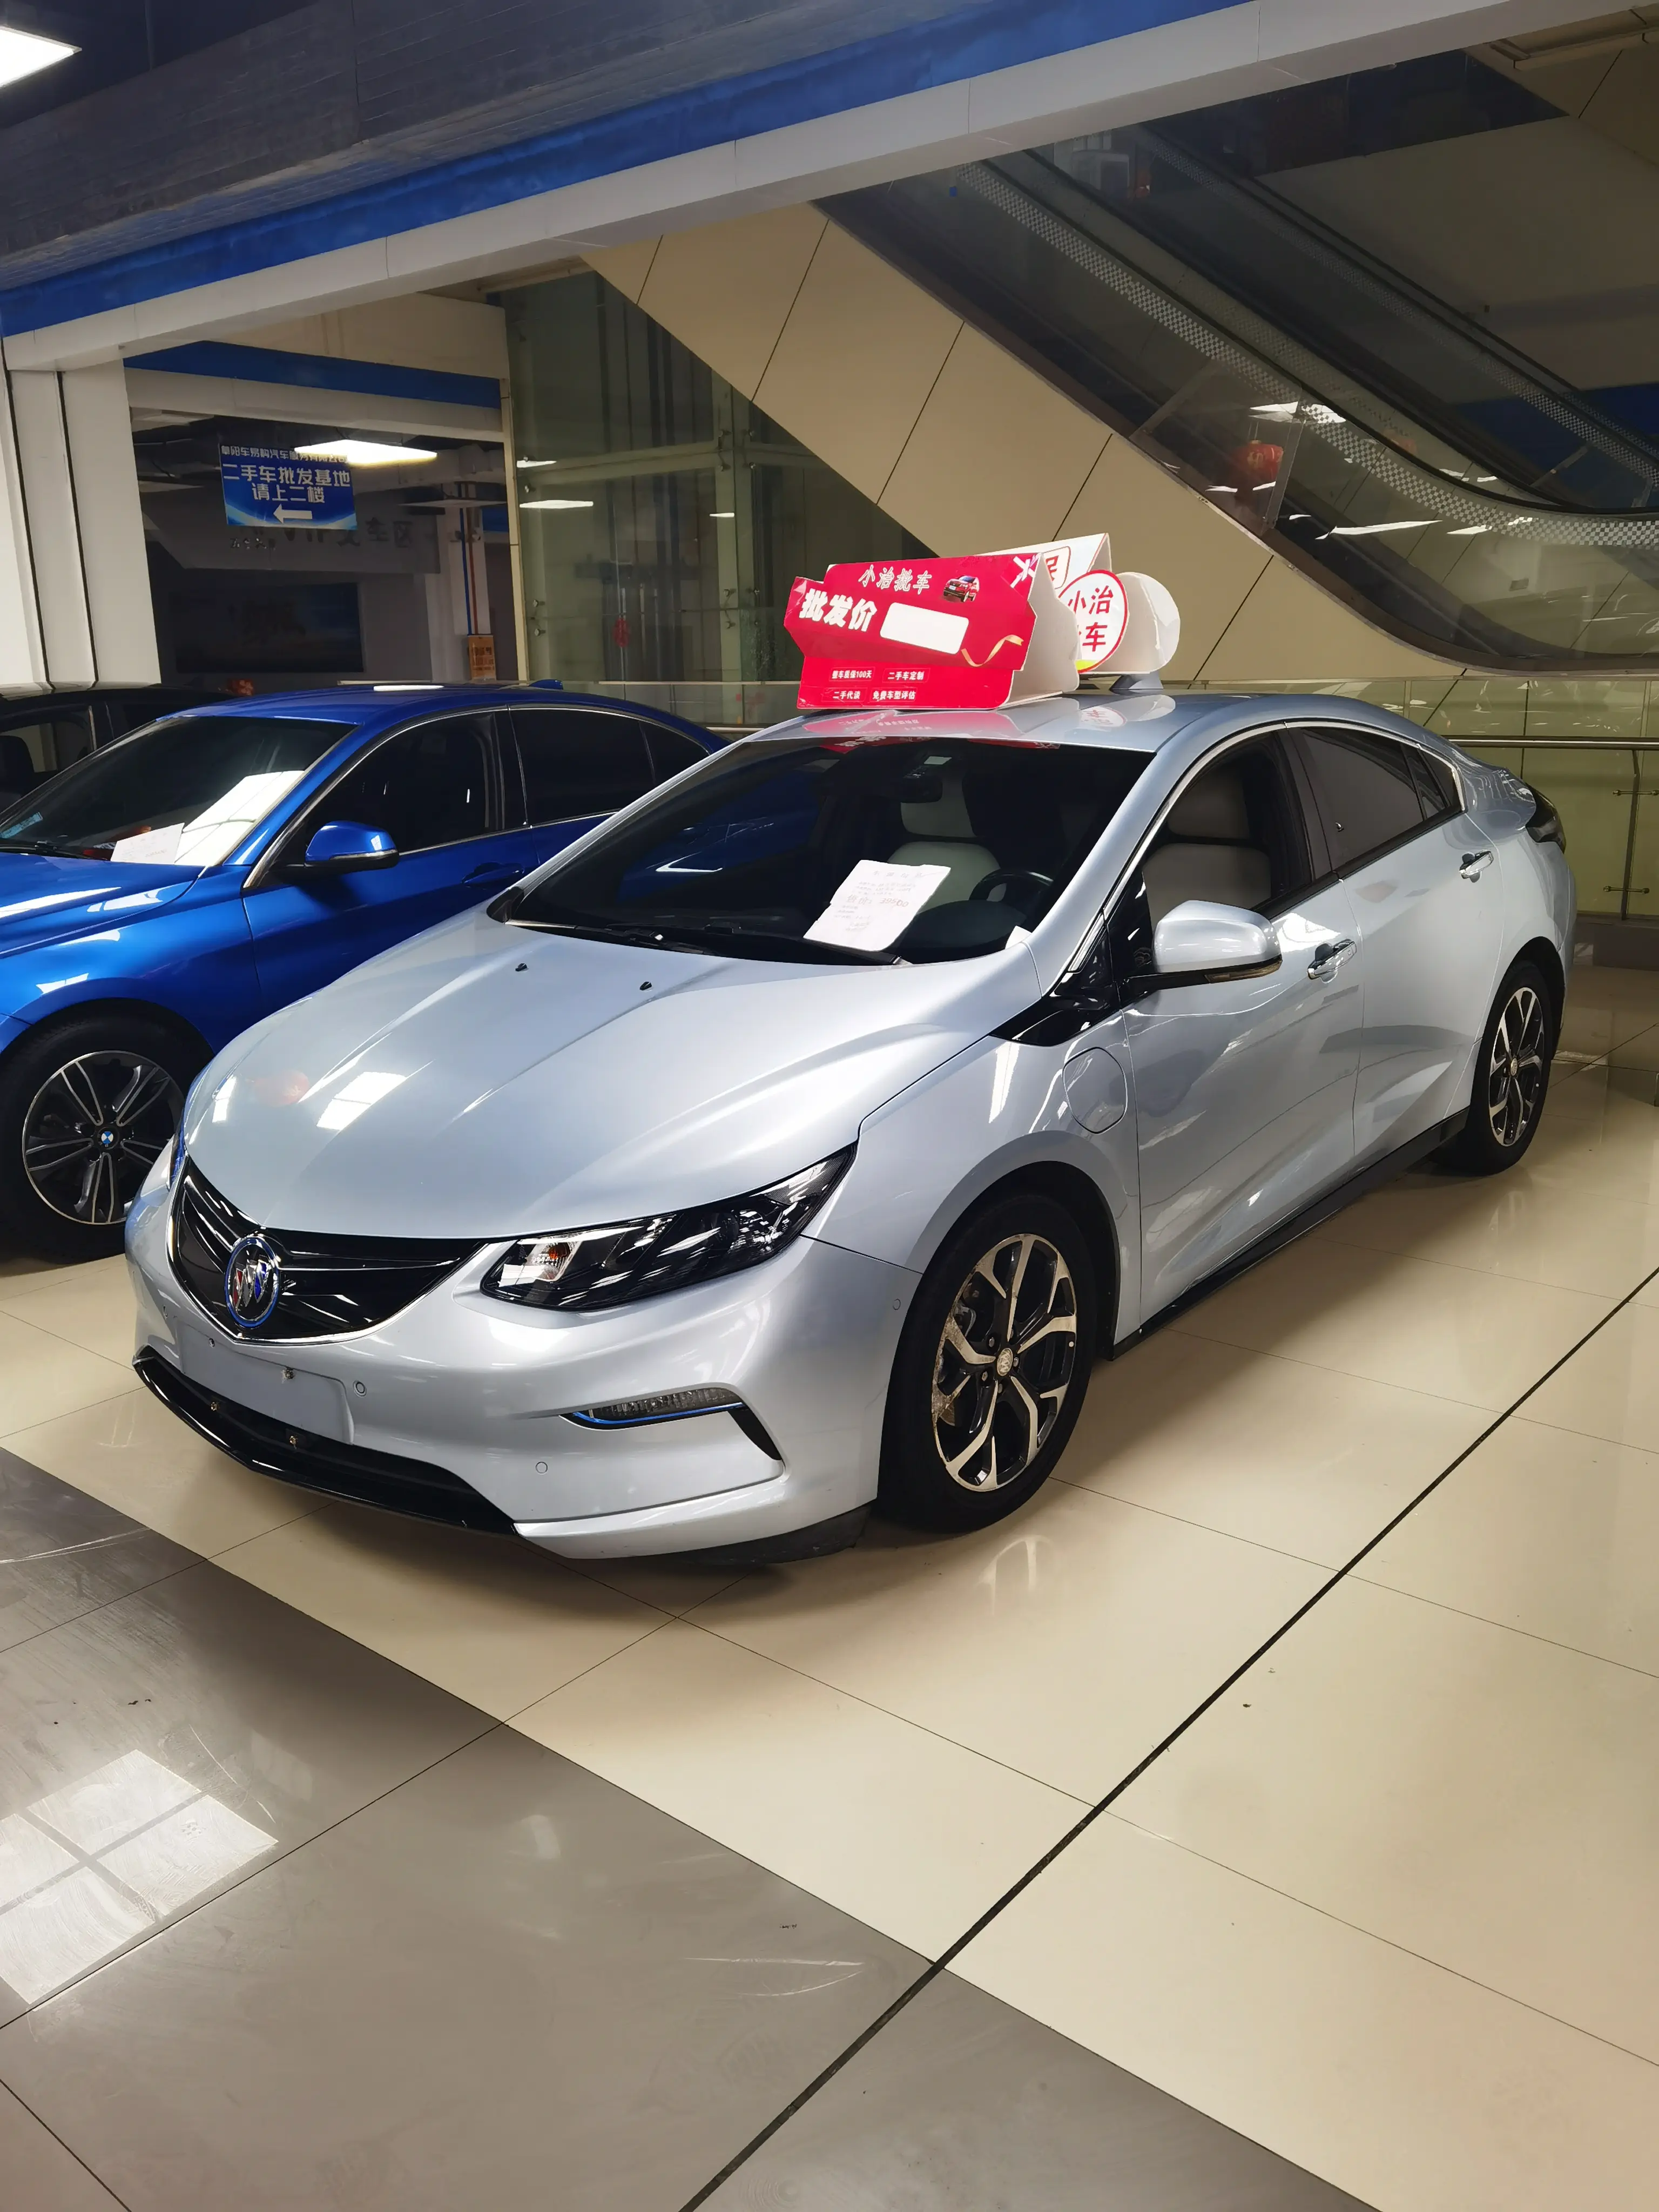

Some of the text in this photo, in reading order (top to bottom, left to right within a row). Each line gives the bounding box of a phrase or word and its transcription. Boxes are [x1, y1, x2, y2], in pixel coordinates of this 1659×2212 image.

[222, 463, 350, 487] 二手车批发基地
[252, 483, 325, 503] 请上二楼
[858, 564, 932, 595] 小治批车
[799, 588, 878, 632] 批发价
[1068, 585, 1114, 615] 小治
[1078, 622, 1108, 652] 车
[832, 670, 872, 679] 整车质保100天
[887, 671, 925, 680] 二手车定制
[872, 690, 916, 700] 免费车型评估
